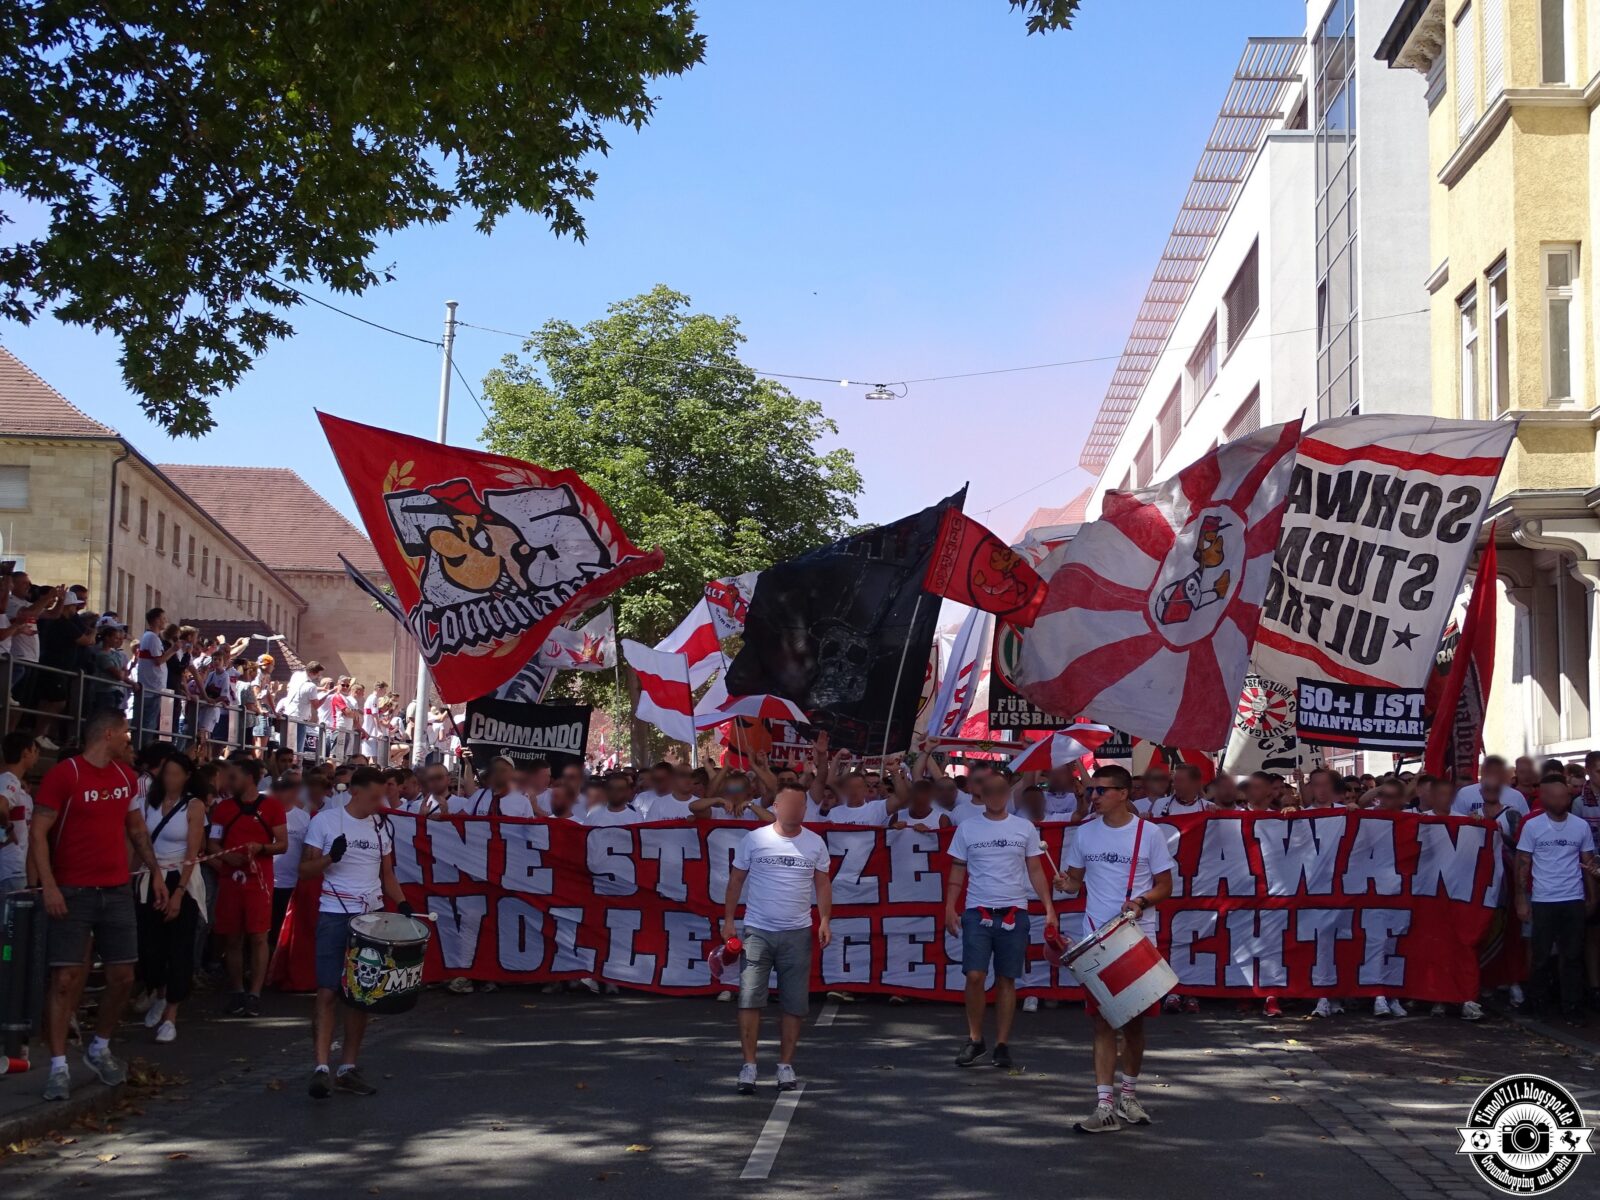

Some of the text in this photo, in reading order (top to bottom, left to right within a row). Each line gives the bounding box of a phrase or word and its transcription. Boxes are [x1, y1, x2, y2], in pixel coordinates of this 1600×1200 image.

[997, 695, 1028, 712] FÜR
[1374, 693, 1425, 718] IST
[470, 712, 583, 749] COMMANDO
[1299, 710, 1424, 735] UNANTASTBAR!
[586, 826, 943, 905] STOZE
